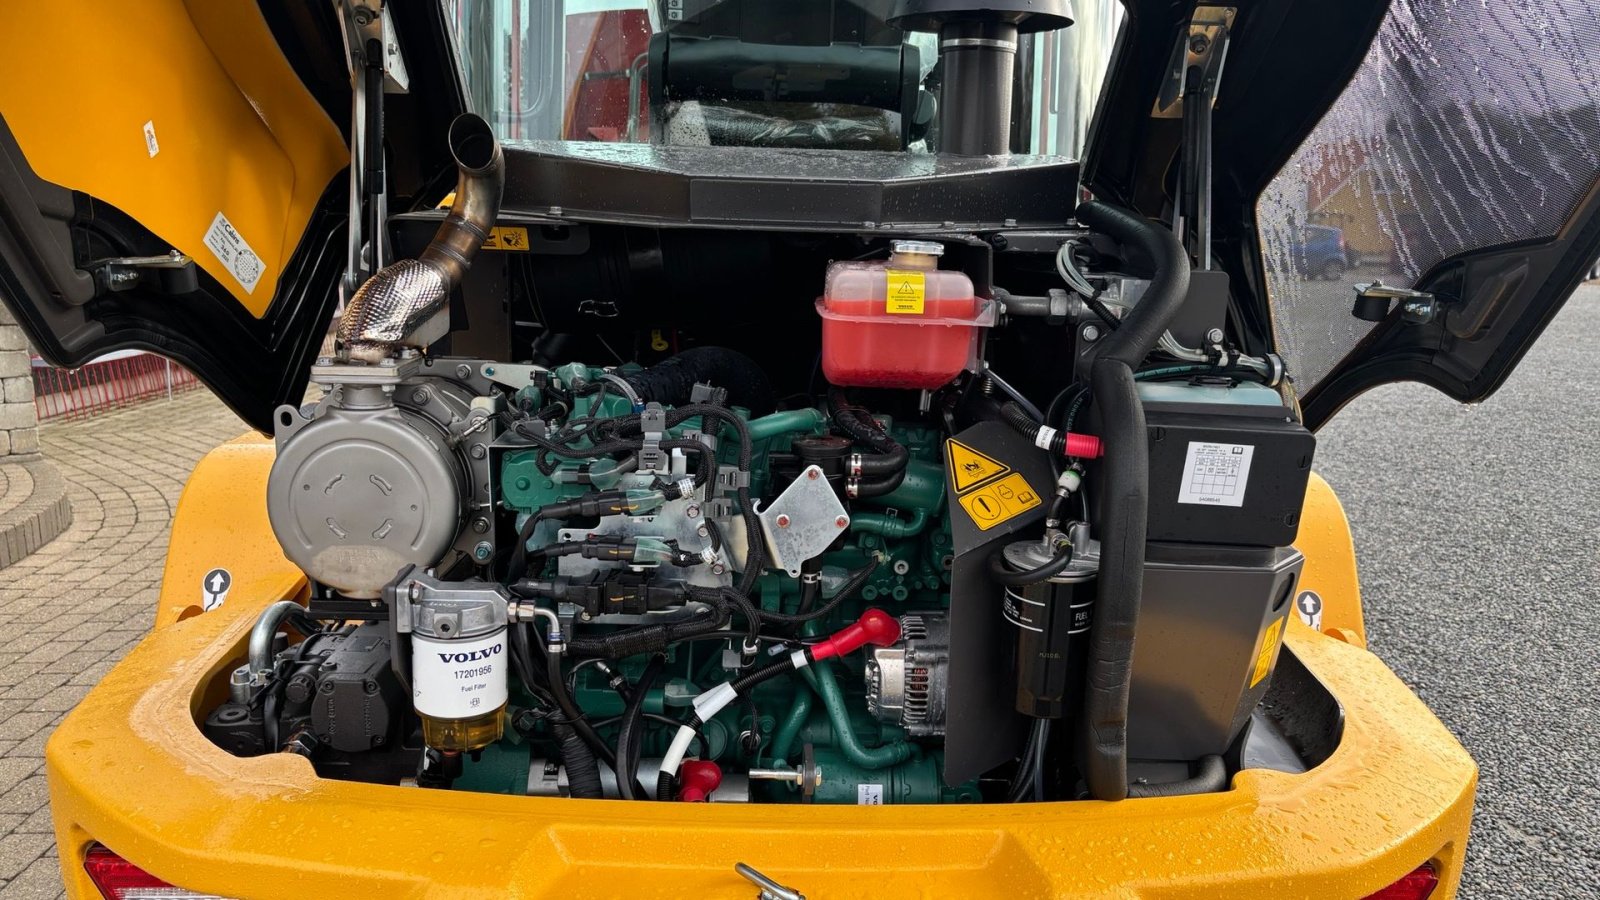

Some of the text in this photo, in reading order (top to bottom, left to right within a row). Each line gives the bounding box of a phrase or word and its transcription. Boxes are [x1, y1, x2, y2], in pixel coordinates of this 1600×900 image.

[437, 643, 502, 663] VOLVO
[454, 664, 492, 680] 17201956
[461, 682, 487, 693] Fuel Filter
